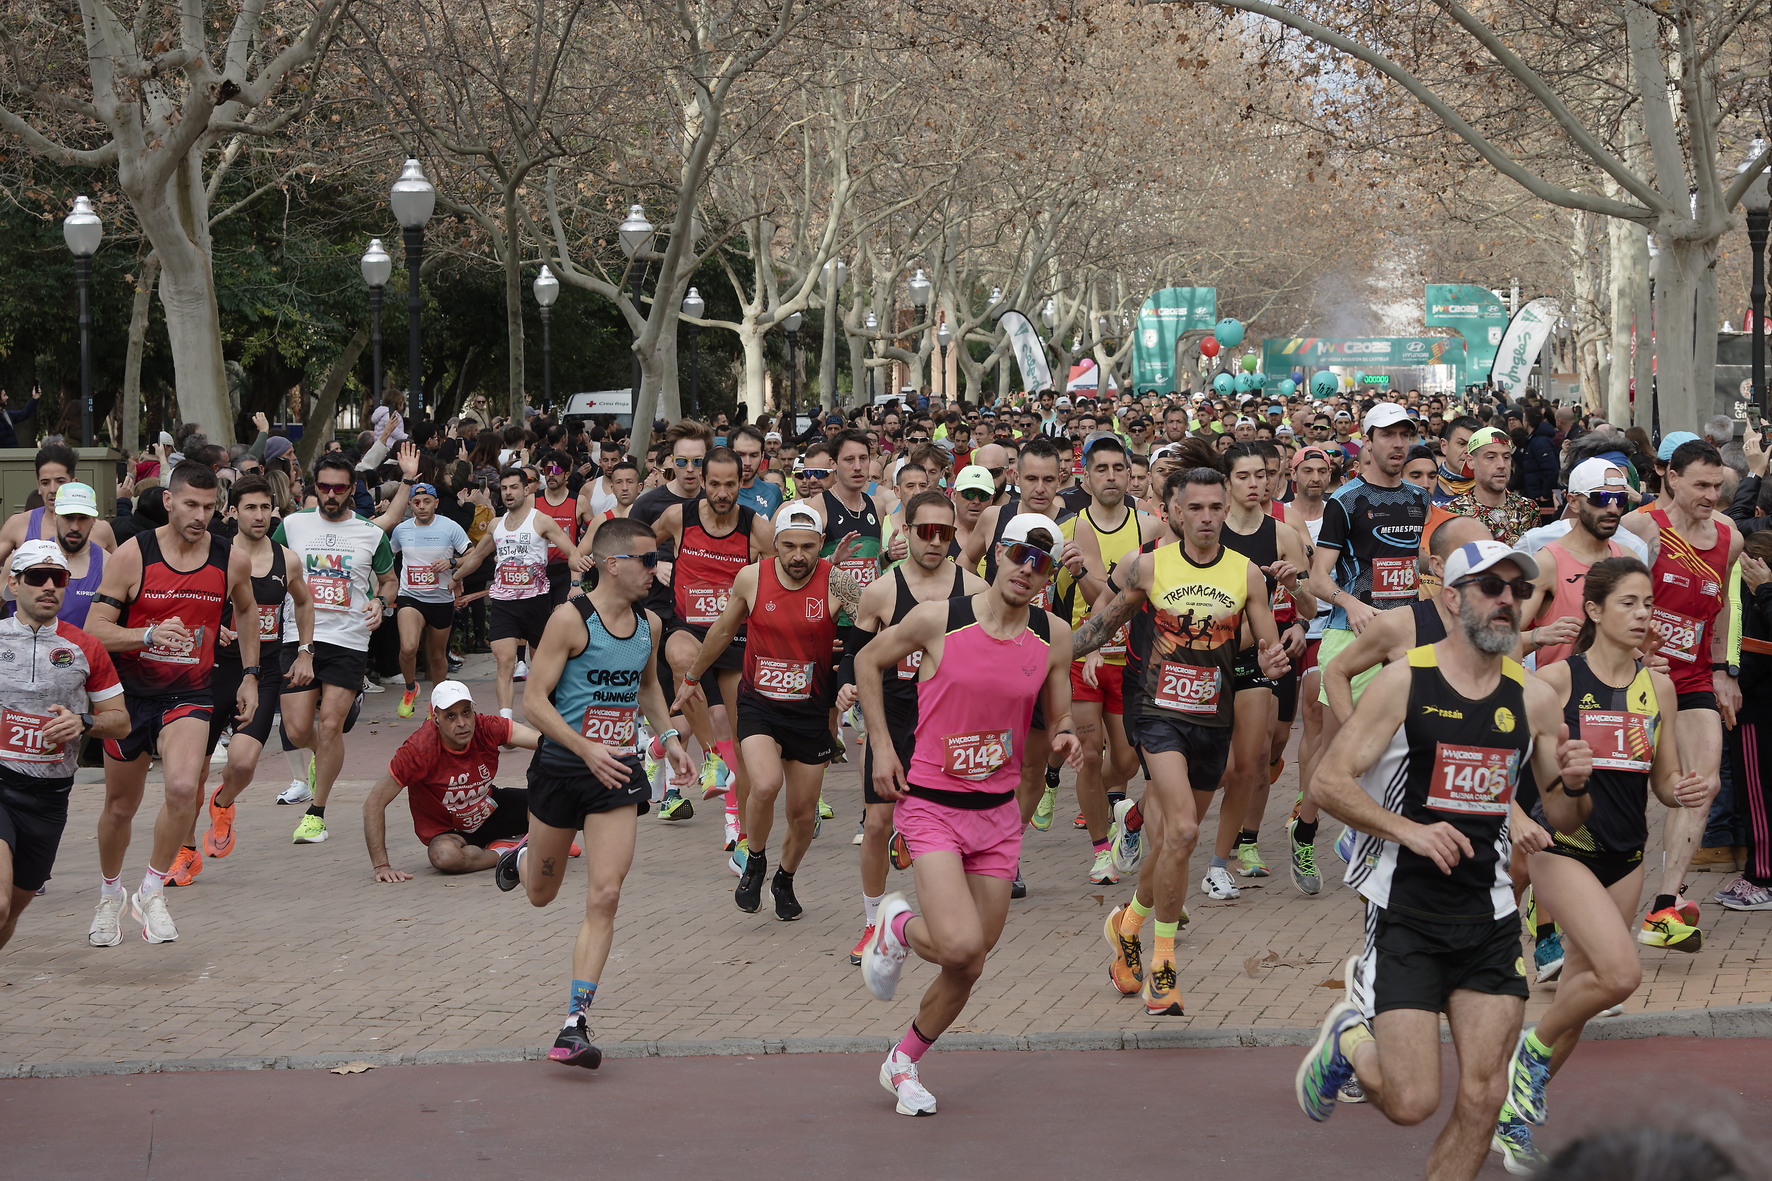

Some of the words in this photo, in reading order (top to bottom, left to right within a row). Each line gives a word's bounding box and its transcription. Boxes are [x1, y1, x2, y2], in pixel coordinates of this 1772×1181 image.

[410, 573, 435, 582] 1563
[504, 572, 529, 582] 1596
[1381, 569, 1414, 586] 1418
[314, 585, 344, 600] 363
[1164, 585, 1235, 608] TRENKACAMES
[695, 597, 727, 612] 436
[1656, 620, 1695, 648] 928
[586, 669, 641, 686] CRESP
[759, 670, 807, 689] 2288
[1162, 676, 1216, 699] 2055
[586, 719, 634, 740] 2050
[1614, 729, 1624, 751] 1
[953, 745, 1004, 770] 2142
[1444, 764, 1508, 794] 1405
